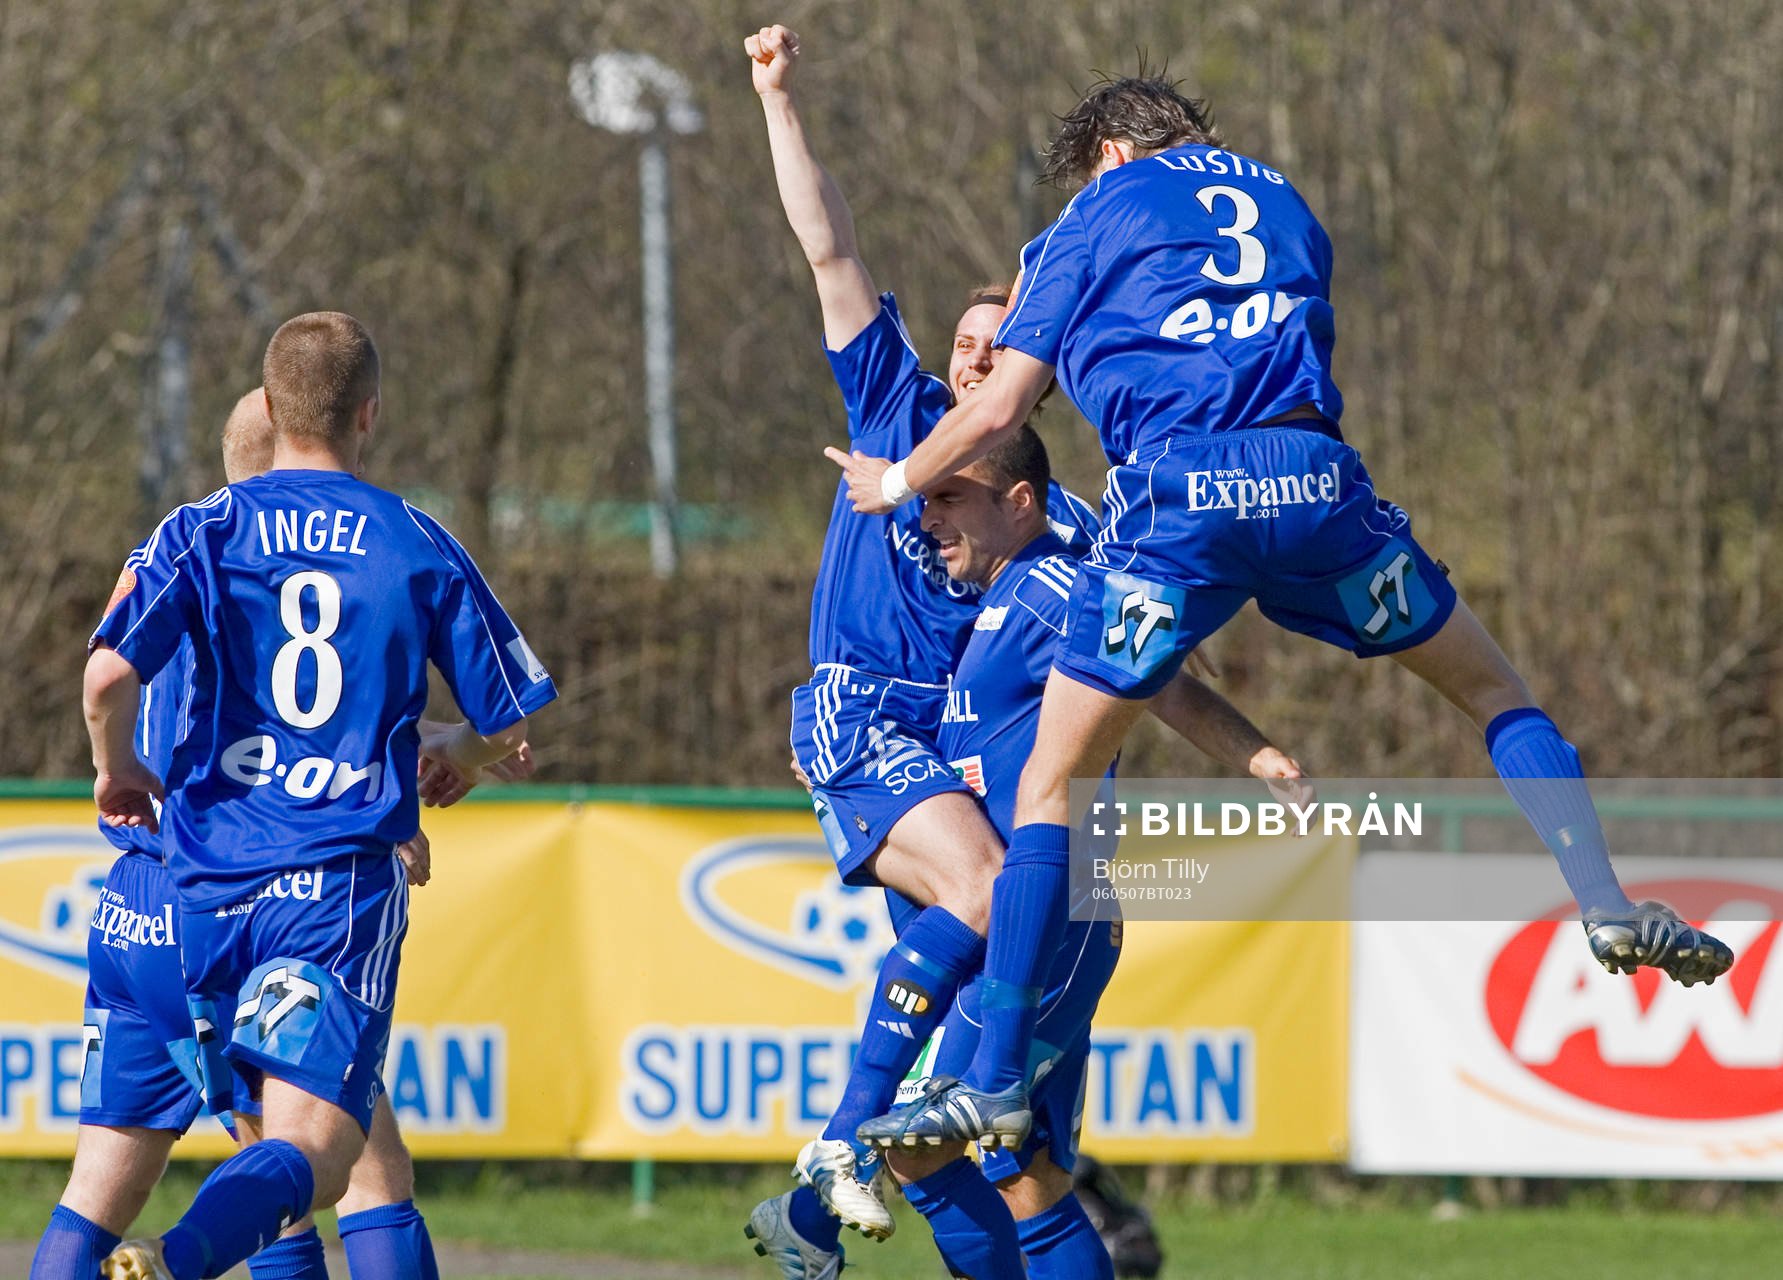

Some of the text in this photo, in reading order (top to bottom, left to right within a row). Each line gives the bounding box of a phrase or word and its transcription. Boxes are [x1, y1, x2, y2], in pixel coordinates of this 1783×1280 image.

[1154, 150, 1284, 185] LUSTIG
[1194, 185, 1268, 286] 3
[1184, 462, 1341, 520] Expancel
[258, 509, 368, 556] INGEL
[271, 570, 344, 729] 8
[884, 759, 949, 796] SCA
